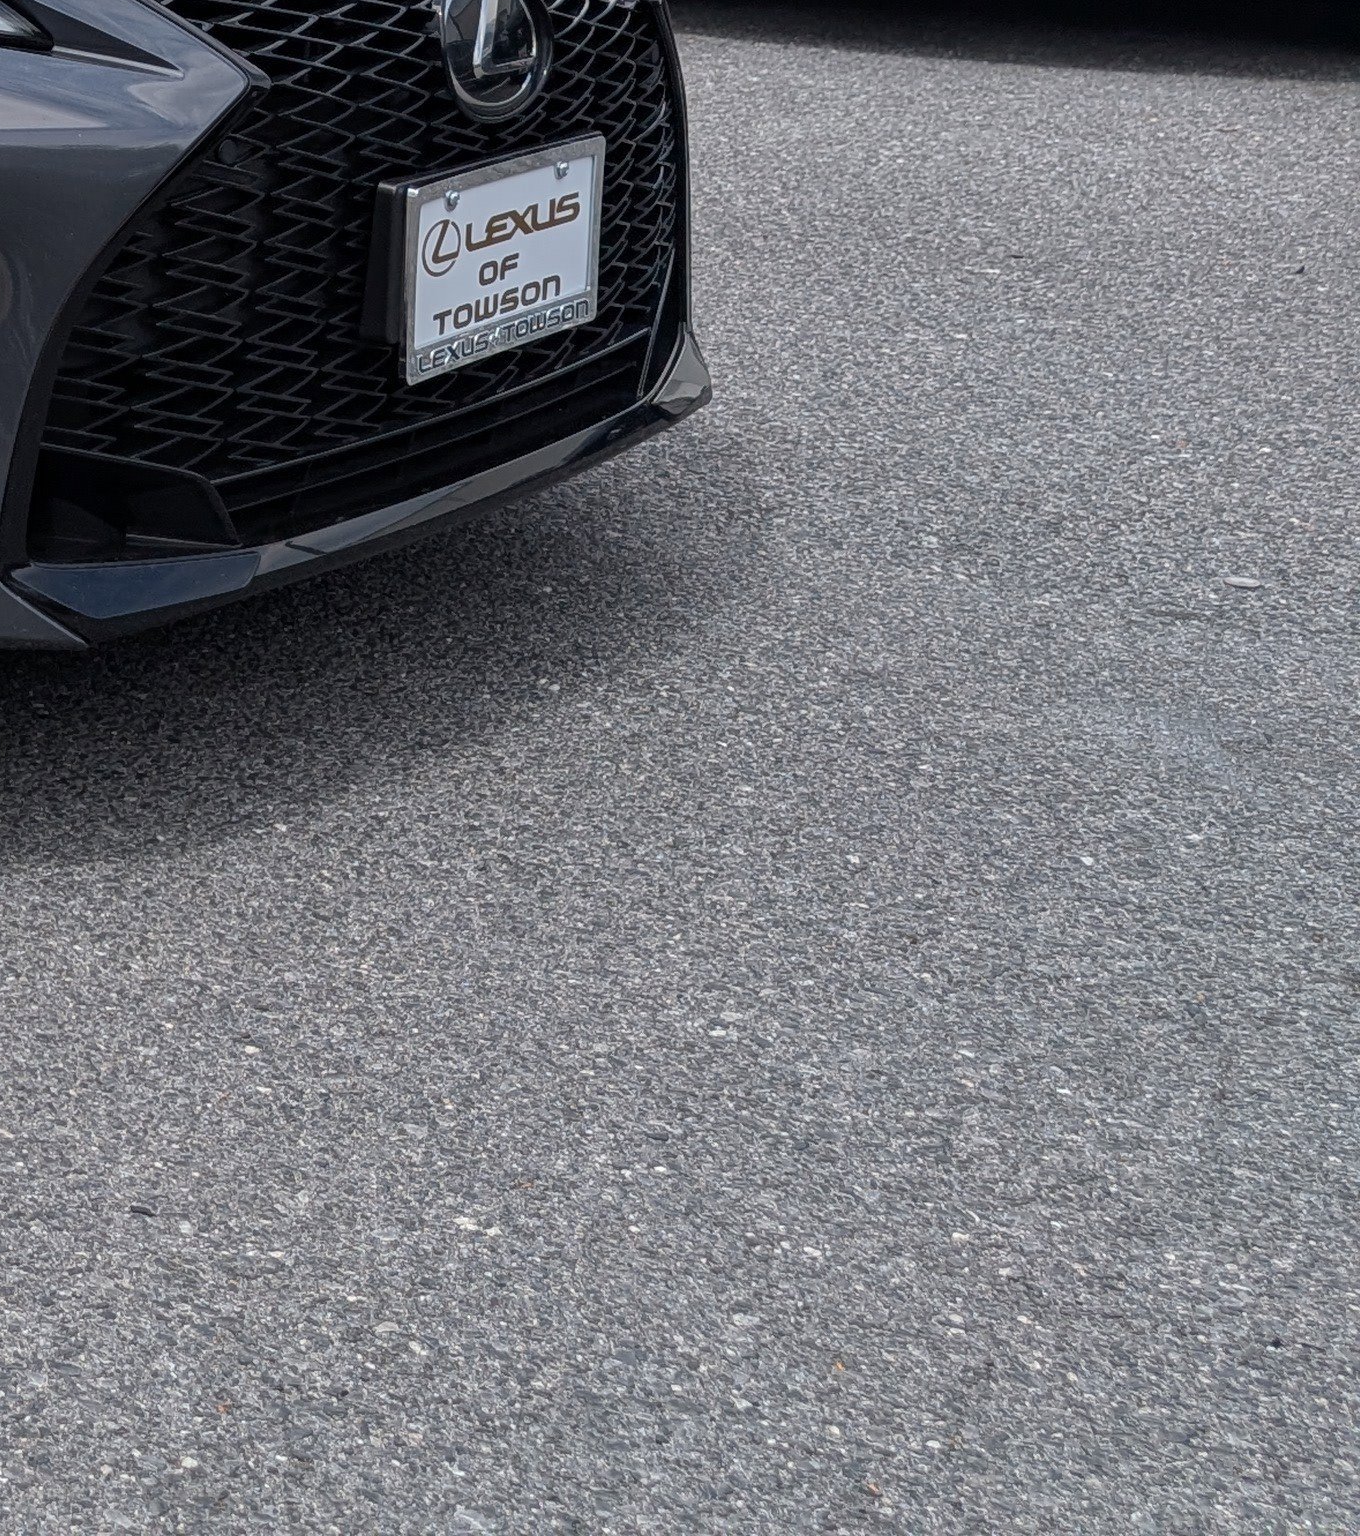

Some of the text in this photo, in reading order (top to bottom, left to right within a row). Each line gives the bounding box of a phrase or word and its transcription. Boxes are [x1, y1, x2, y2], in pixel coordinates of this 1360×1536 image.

[465, 191, 581, 253] LEXUS
[478, 252, 520, 286] OF
[432, 275, 561, 336] TOWSON
[416, 331, 489, 374] LEXUS
[501, 299, 589, 340] TOWSON
